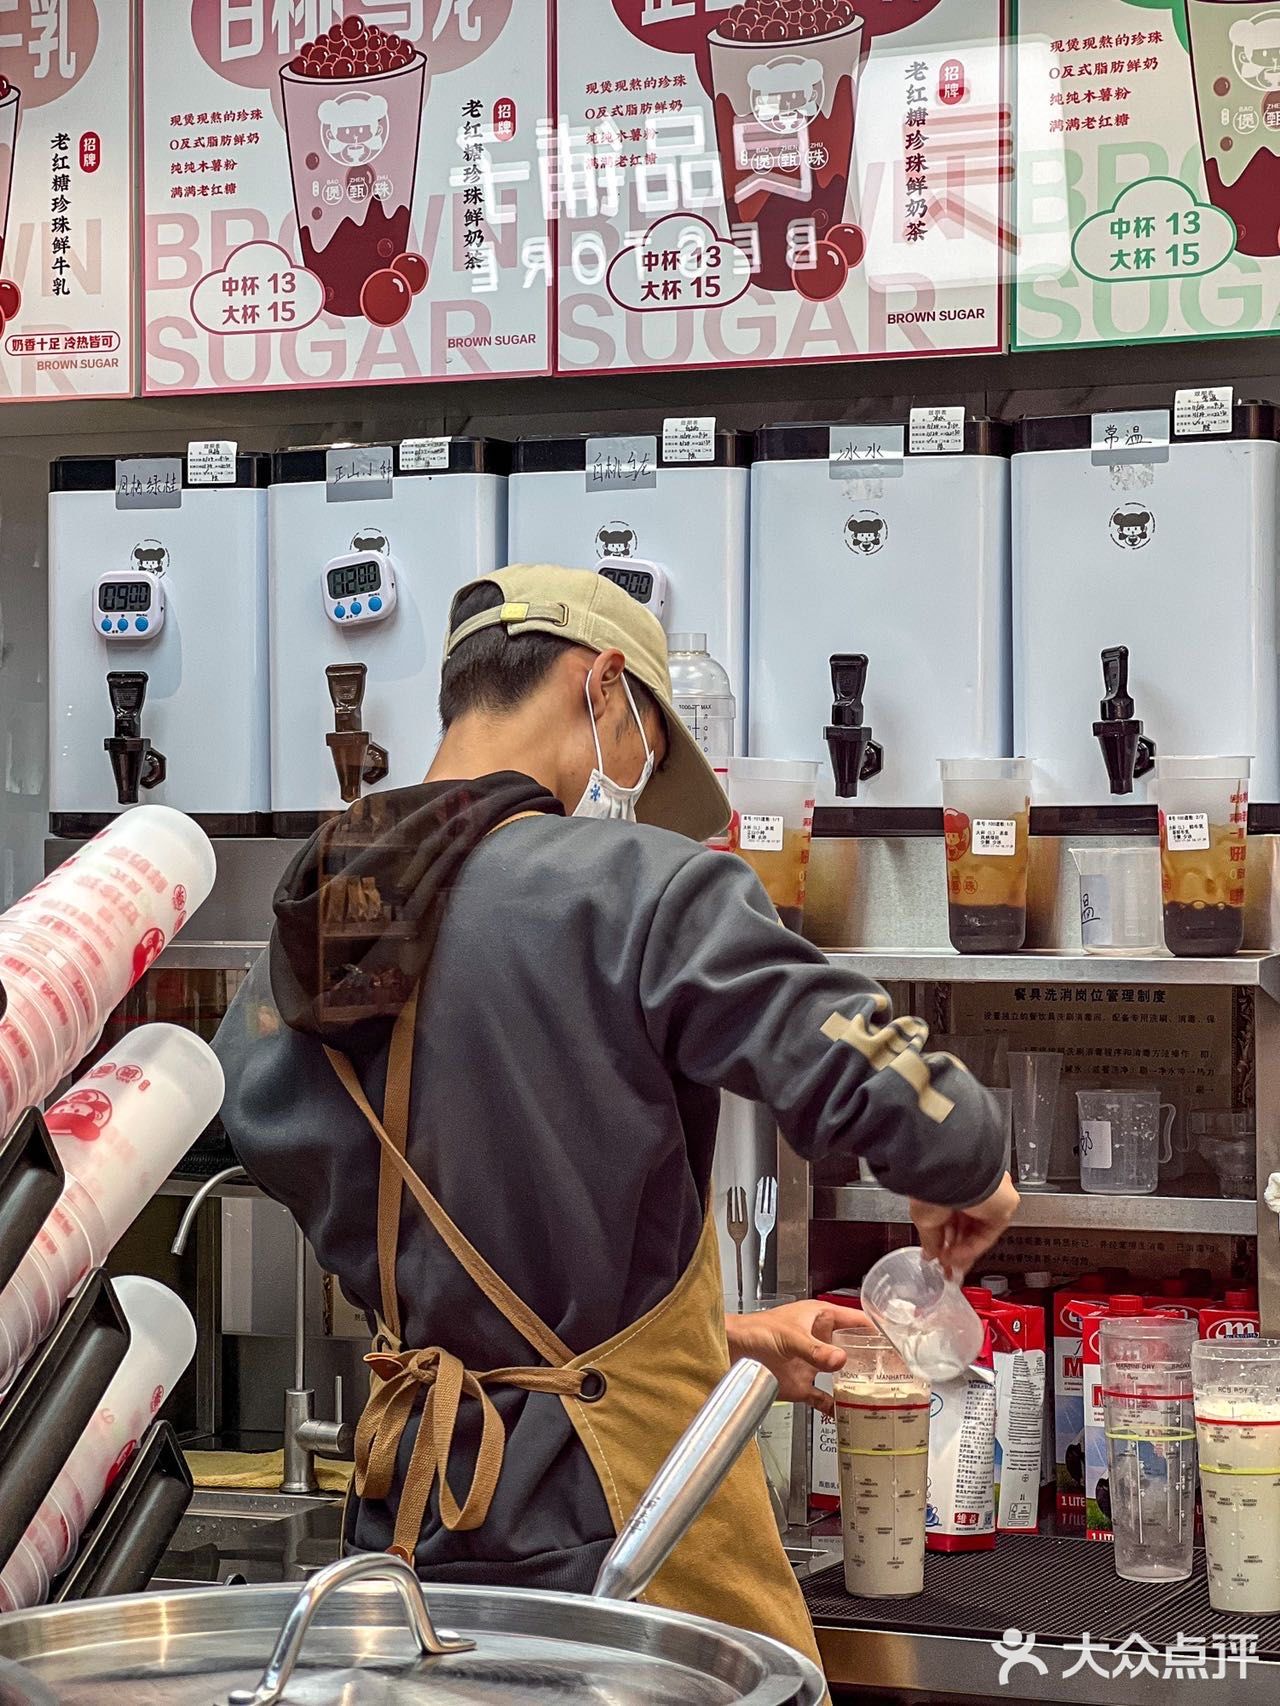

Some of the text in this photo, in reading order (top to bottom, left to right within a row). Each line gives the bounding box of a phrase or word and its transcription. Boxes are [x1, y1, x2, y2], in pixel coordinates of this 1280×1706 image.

[0, 0, 76, 78] 乳
[1049, 30, 1163, 53] 现煲现熬的珍珠
[585, 74, 687, 95] 现煲现熬的珍珠
[944, 66, 960, 99] 招牌
[1049, 87, 1131, 106] 纯纯木薯粉
[170, 108, 263, 127] 现煲现熬的珍珠
[498, 103, 512, 138] 招牌
[1049, 113, 1130, 133] 满满老红糖
[585, 128, 658, 145] 纯纯木薯粉
[82, 137, 97, 168] 招牌
[586, 153, 658, 169] 满满老红糖
[905, 61, 928, 242] 老红糖珍珠鲜奶茶
[170, 158, 237, 175] 纯纯木薯粉
[170, 181, 236, 199] 满满老红糖
[462, 99, 484, 270] 老红糖珍珠鲜奶茶
[51, 133, 71, 296] 老红糖珍珠鲜牛乳
[1110, 210, 1201, 241] 中杯 13
[642, 246, 721, 272] 中杯 13
[1109, 242, 1200, 272] 大杯 15
[222, 271, 297, 298] 中杯 13
[641, 276, 721, 300] 大杯 15
[221, 301, 296, 325] 大杯 15
[887, 307, 985, 325] BROWN SUGAR
[12, 335, 113, 352] 奶香十足 冷热皆可
[447, 332, 536, 349] BROWN SUGAR
[37, 357, 119, 371] BROWN SUGAR
[1104, 424, 1152, 450] 常温
[837, 442, 884, 461] 冰水
[334, 460, 392, 485] 正山小种
[593, 452, 651, 482] 白桃乌龙
[1014, 987, 1167, 1003] 餐具洗消岗位管理制度
[819, 1434, 837, 1444] Cre
[819, 1443, 837, 1453] Con
[1069, 1496, 1086, 1507] LITE
